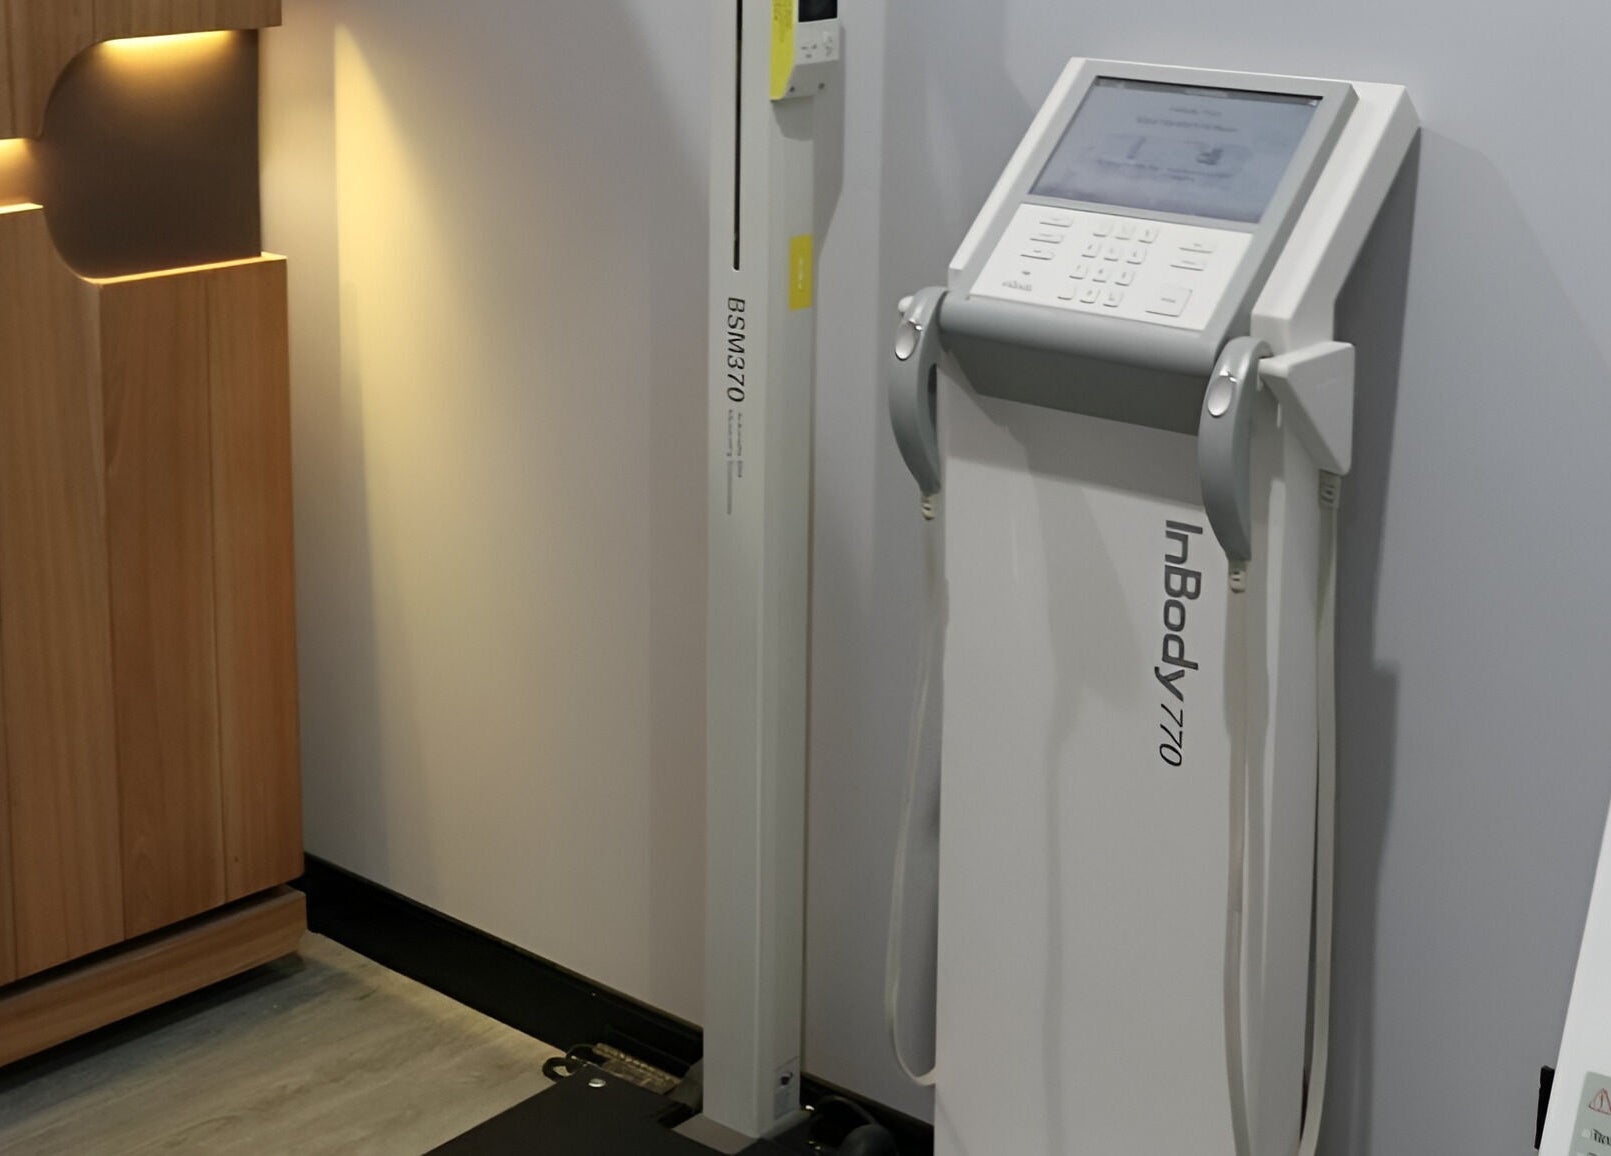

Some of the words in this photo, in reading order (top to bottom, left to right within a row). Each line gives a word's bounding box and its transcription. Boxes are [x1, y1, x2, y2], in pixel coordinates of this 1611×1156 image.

[727, 297, 746, 402] BSM370
[1155, 520, 1203, 701] InBody
[1159, 703, 1183, 767] 770
